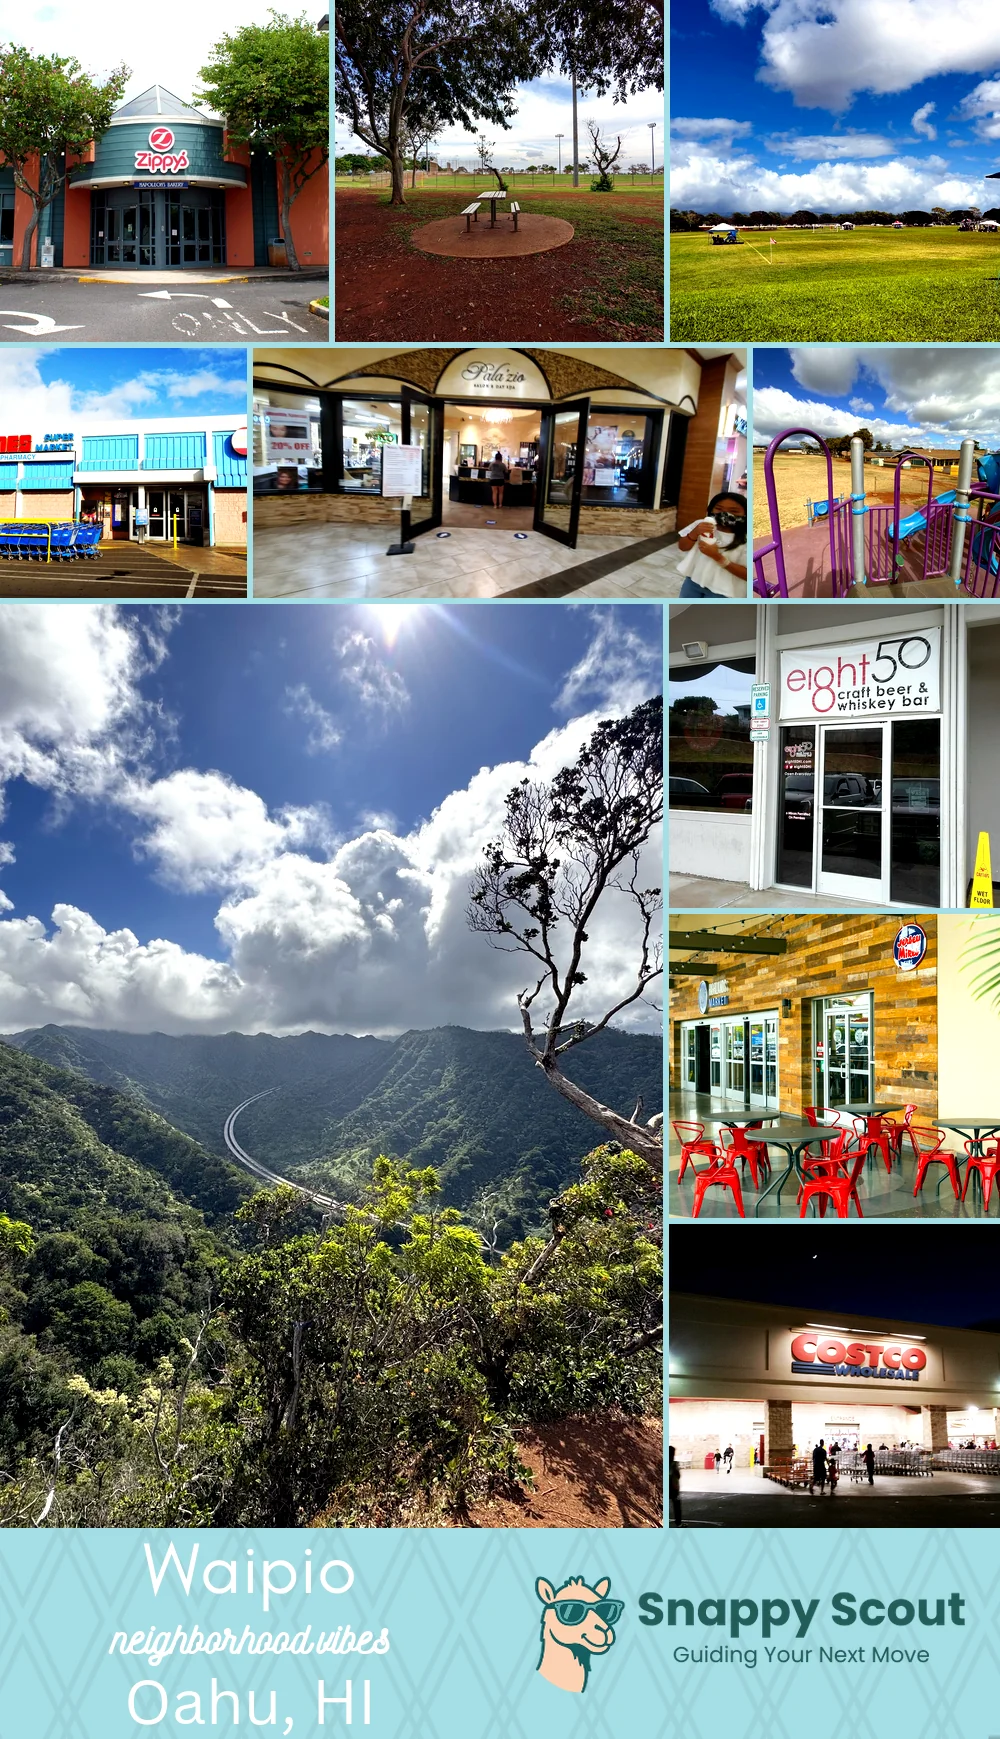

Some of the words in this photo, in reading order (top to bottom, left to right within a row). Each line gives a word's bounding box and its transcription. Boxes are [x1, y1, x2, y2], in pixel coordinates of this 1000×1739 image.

[136, 151, 188, 172] Zippy's
[172, 311, 309, 336] ONLY
[44, 433, 74, 443] SUPER
[271, 442, 292, 450] 20%
[294, 442, 310, 450] OFF
[35, 443, 74, 451] MARKET
[837, 686, 871, 700] craft
[876, 684, 912, 697] beer
[919, 682, 929, 693] &
[837, 698, 895, 711] whiskey
[902, 695, 930, 707] bar
[974, 897, 991, 905] FLOOR
[709, 996, 729, 1007] MARKET
[791, 1333, 927, 1371] COSTCO
[834, 1365, 919, 1381] WHOLESALE
